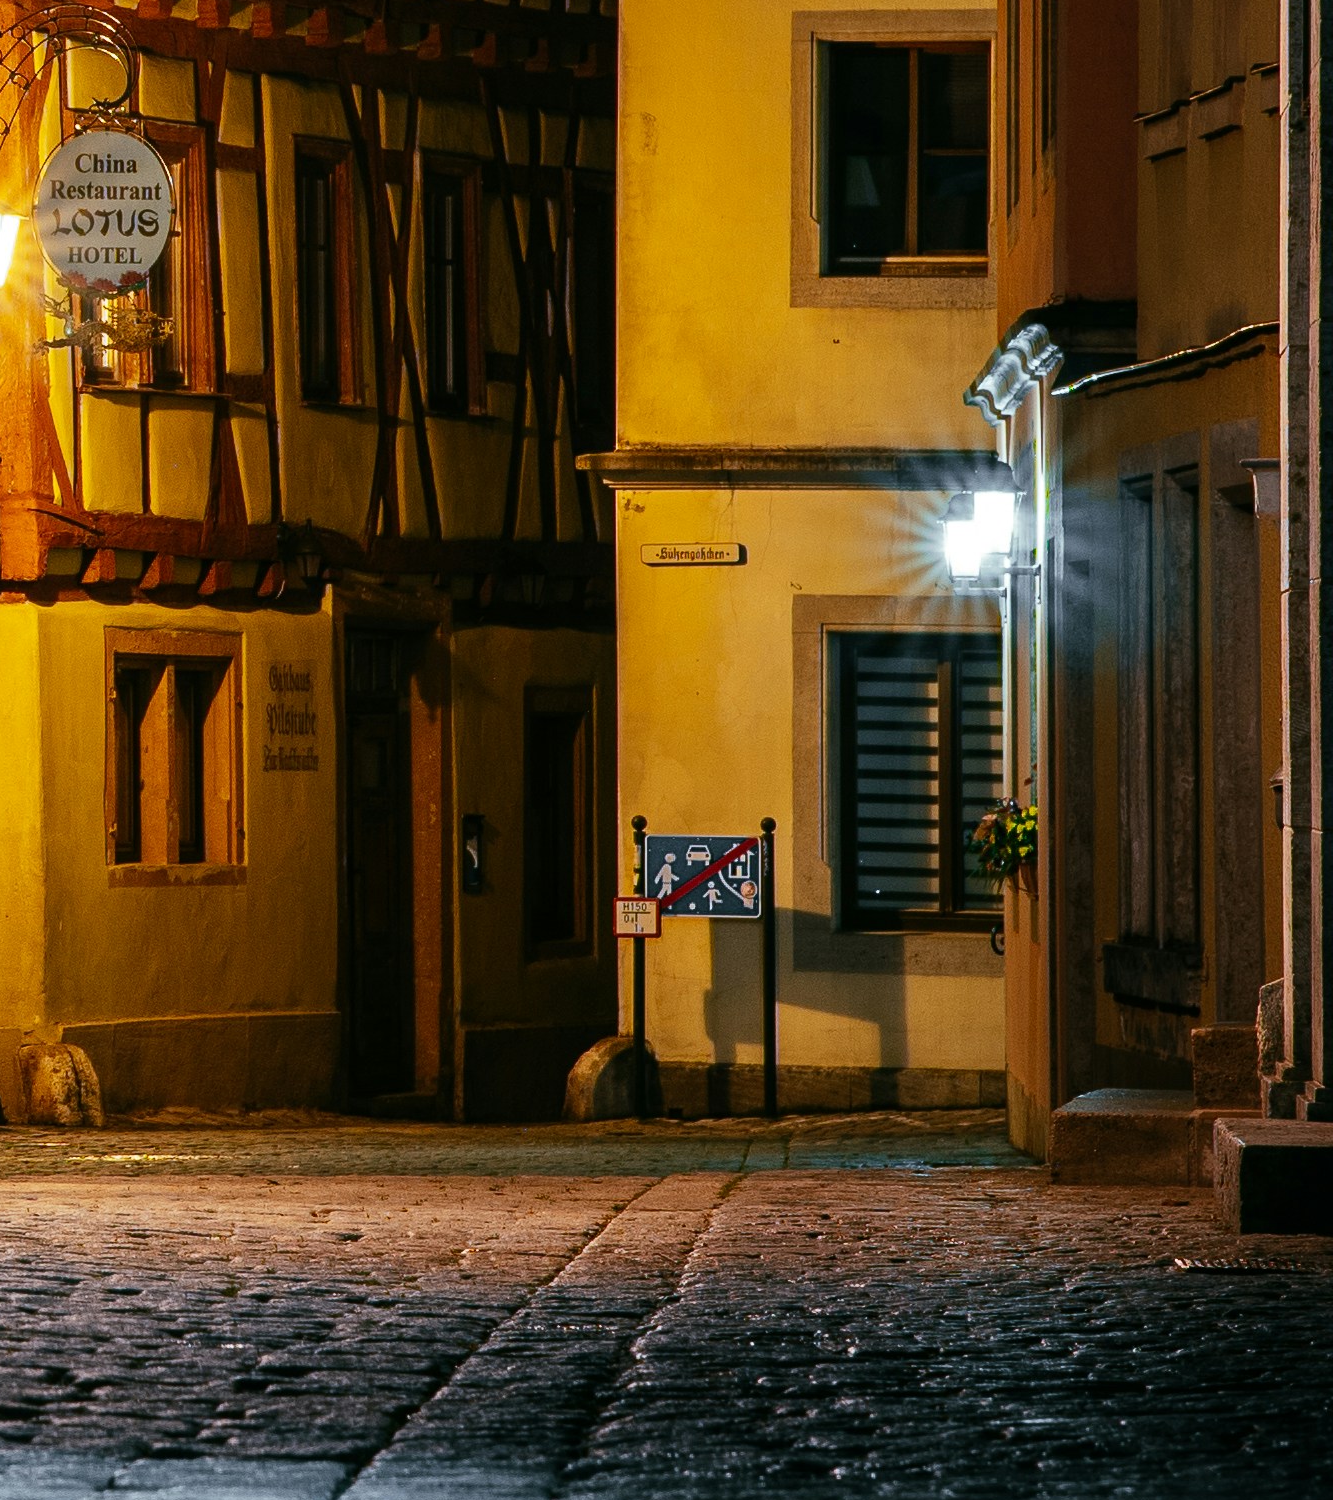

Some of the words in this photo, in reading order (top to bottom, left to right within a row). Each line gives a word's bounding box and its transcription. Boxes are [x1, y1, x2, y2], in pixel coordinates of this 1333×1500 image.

[74, 153, 138, 175] China
[49, 179, 162, 201] Restaurant
[51, 208, 160, 238] LOTUS
[67, 246, 143, 265] HOTEL
[623, 902, 647, 911] H150
